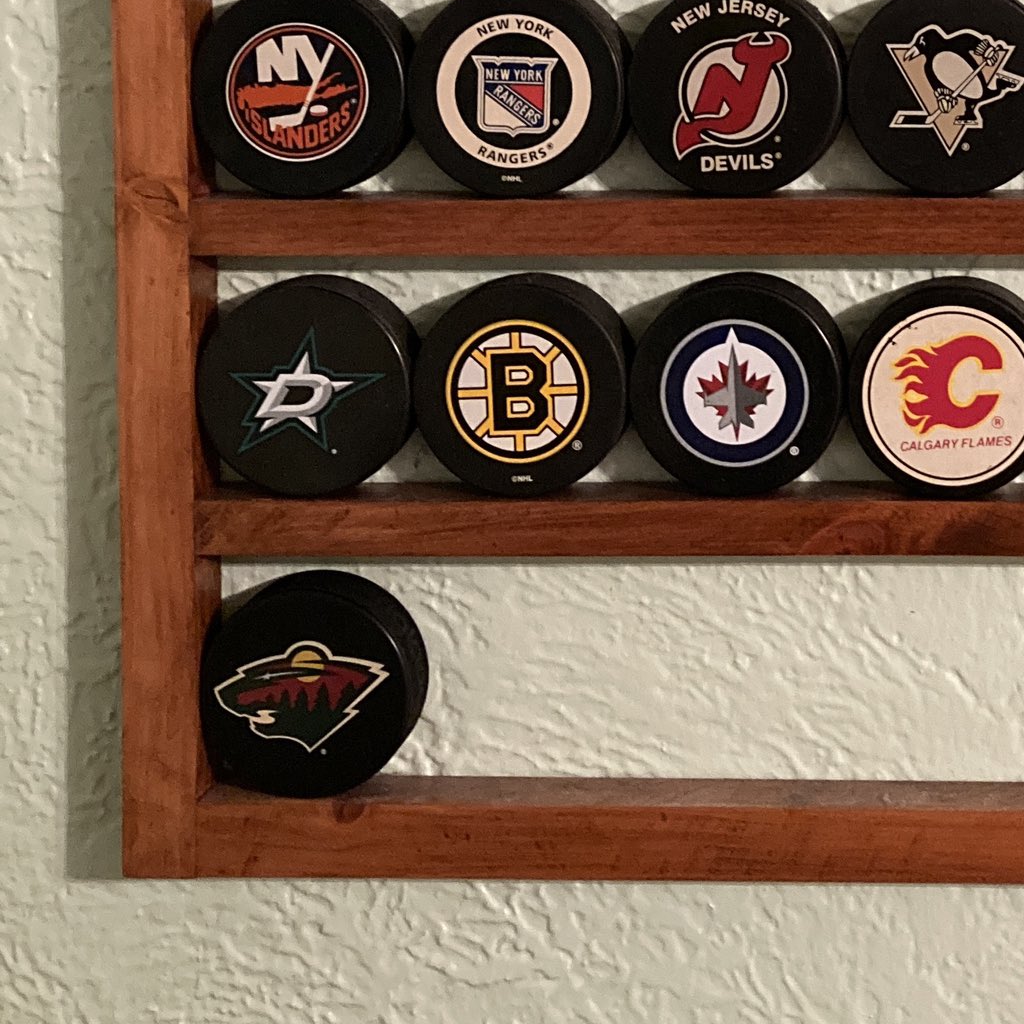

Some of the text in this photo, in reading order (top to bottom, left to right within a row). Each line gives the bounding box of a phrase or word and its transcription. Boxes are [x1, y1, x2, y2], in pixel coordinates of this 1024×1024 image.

[670, 0, 790, 34] NEW JERSEY
[477, 18, 554, 40] NEW YORK
[485, 68, 543, 82] NEW YORK
[493, 84, 542, 125] RANGERS
[245, 102, 351, 148] ISLANDERS
[477, 145, 547, 164] RANGERS
[701, 152, 774, 172] DEVILS
[900, 436, 1012, 452] CALGARY FLAMES
